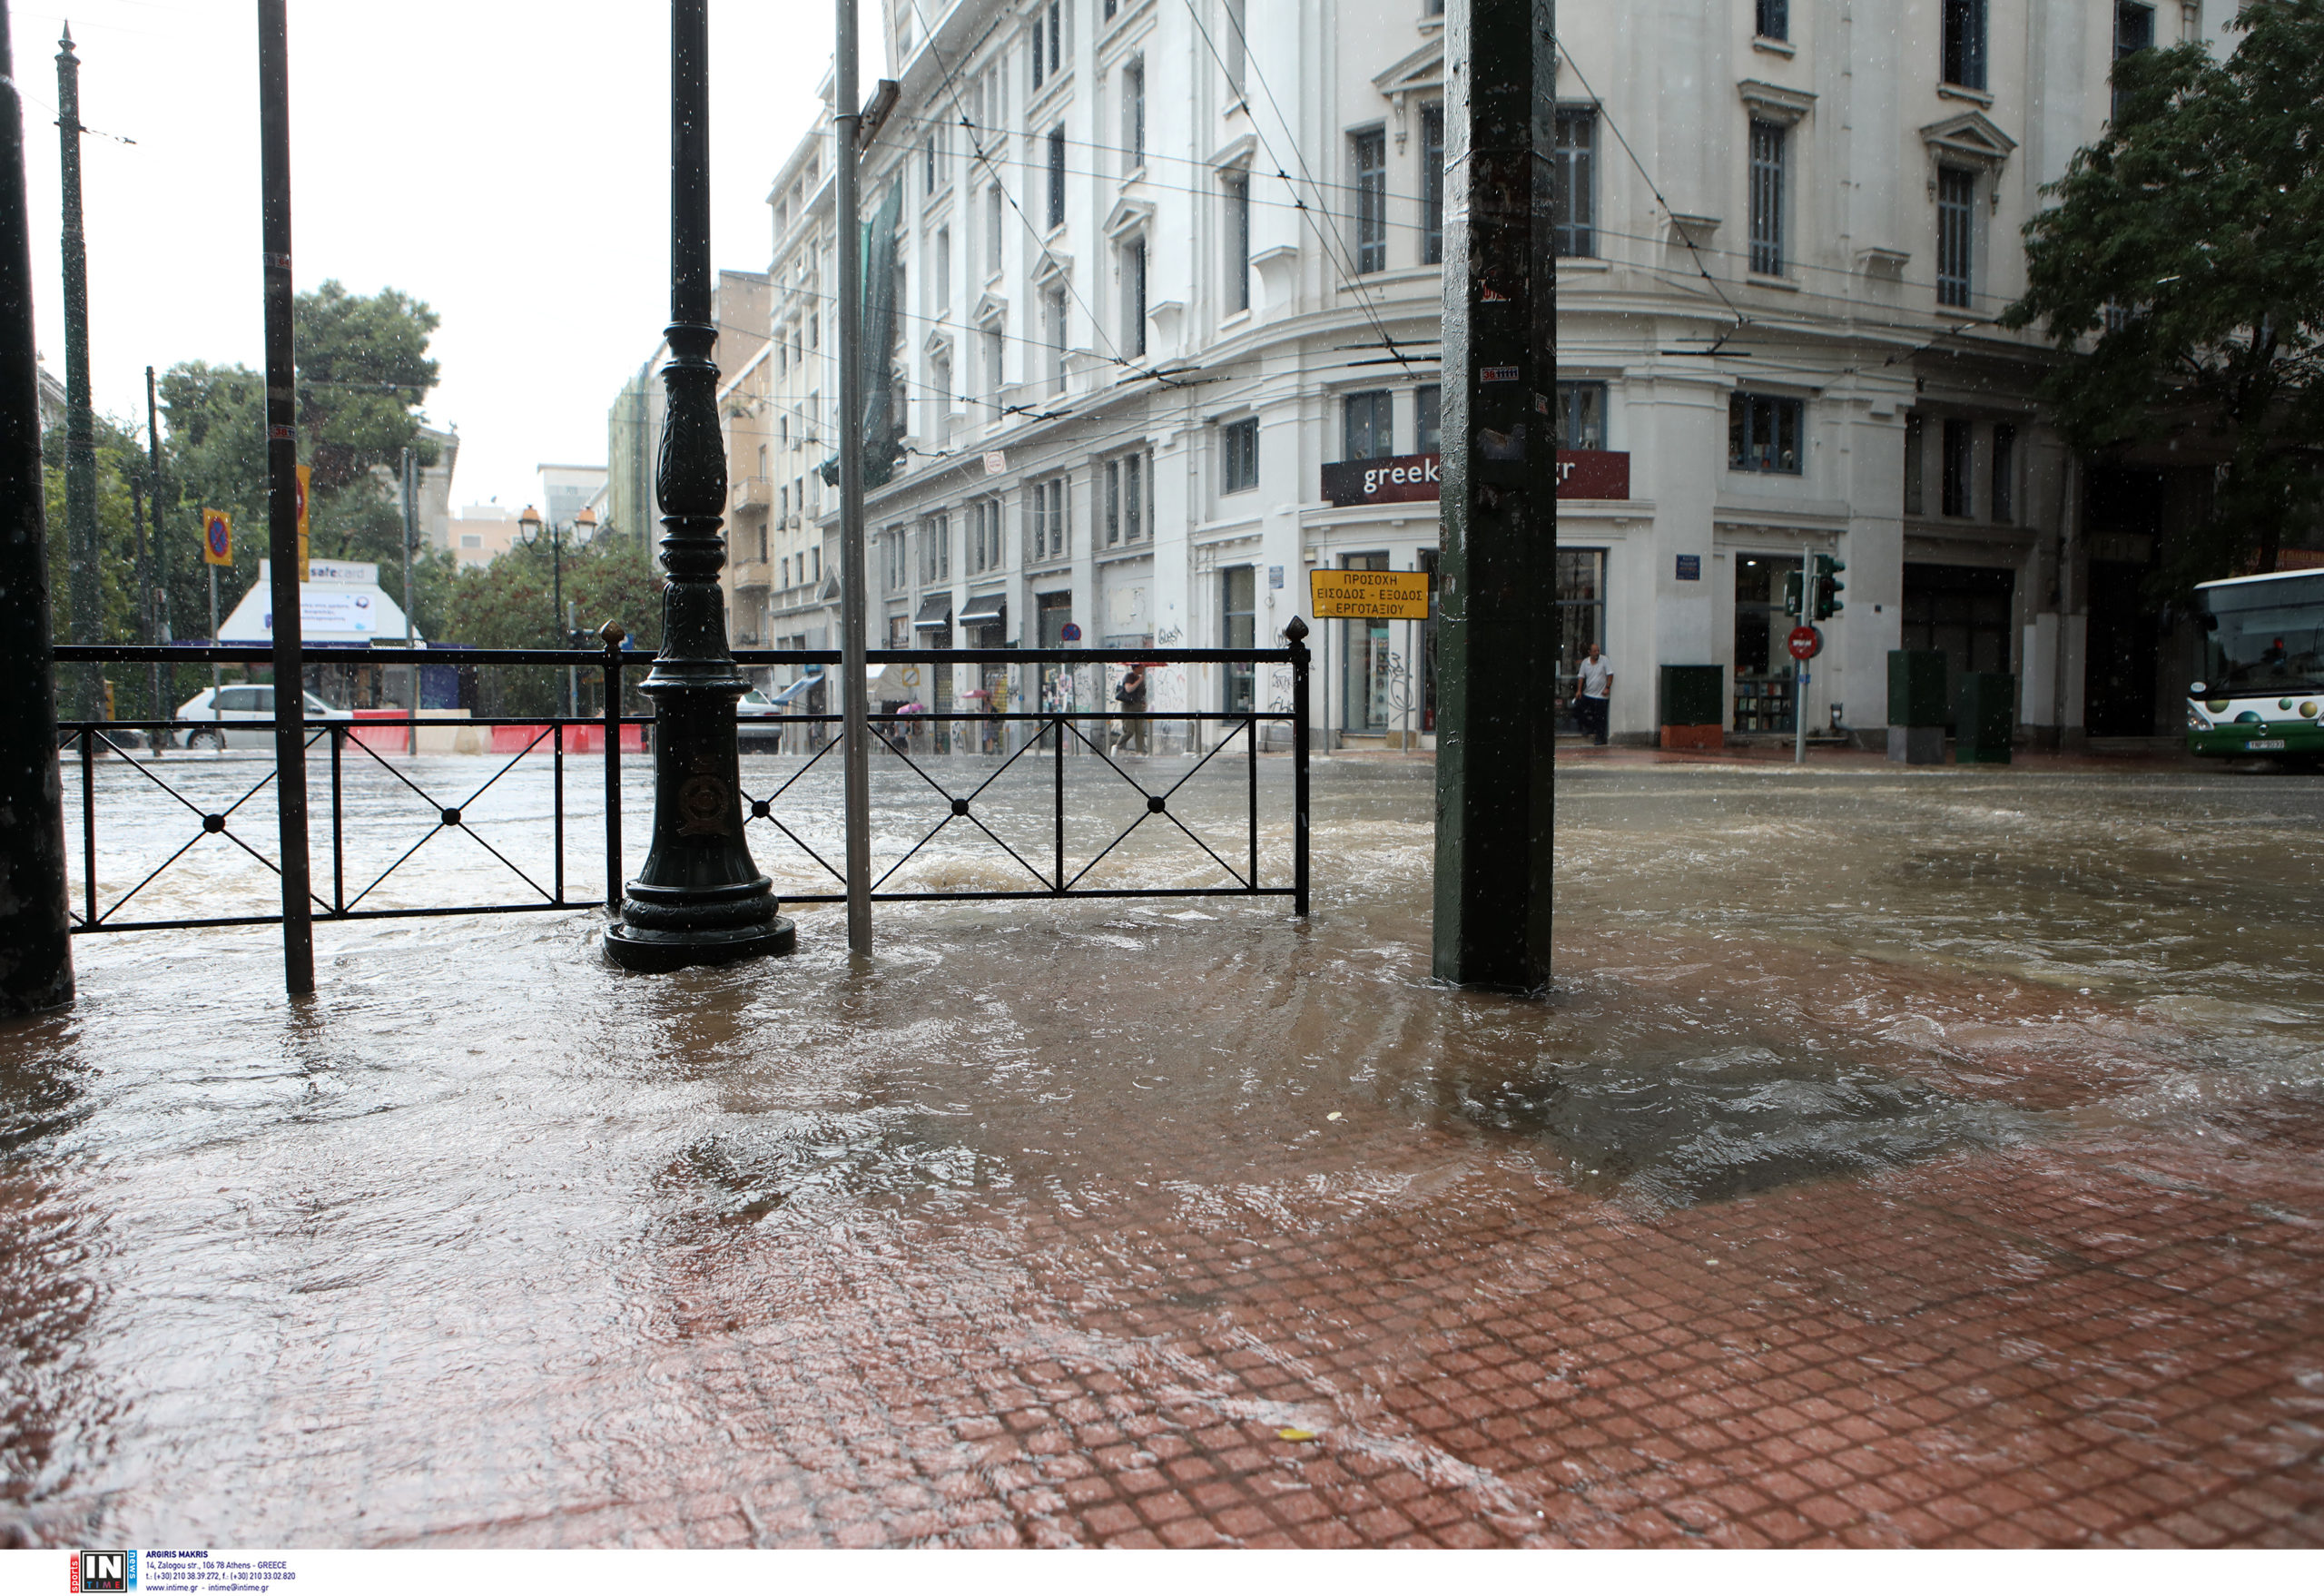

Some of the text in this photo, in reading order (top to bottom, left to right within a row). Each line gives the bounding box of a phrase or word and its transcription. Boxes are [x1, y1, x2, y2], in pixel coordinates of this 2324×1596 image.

[1344, 574, 1398, 586] ΠΡΟΣΟΧΗ
[1317, 588, 1365, 599] ΕΙΣΟΔΟΣ
[1379, 589, 1423, 601] ΕΞΟΔΟΣ
[1336, 603, 1404, 615] ΕΡΓΟΤΑΞΙΟΥ
